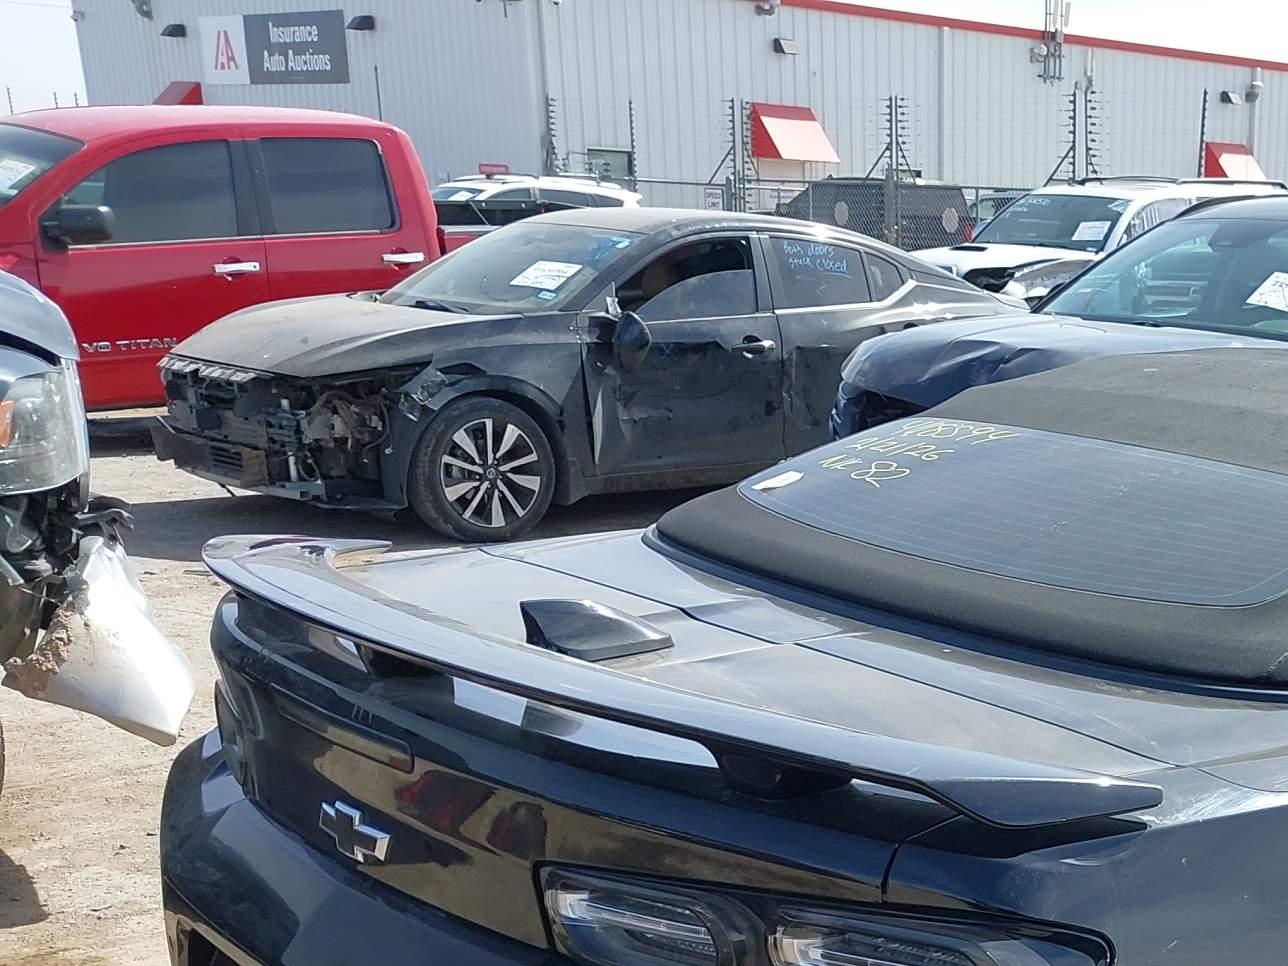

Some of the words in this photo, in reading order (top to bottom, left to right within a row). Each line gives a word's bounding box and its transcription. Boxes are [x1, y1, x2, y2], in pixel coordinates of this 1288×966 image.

[268, 22, 318, 43] Insurance
[263, 50, 286, 72] Auto
[288, 48, 331, 71] Auctions
[807, 243, 834, 257] doors
[115, 337, 177, 351] TITAN
[850, 460, 911, 488] 82
